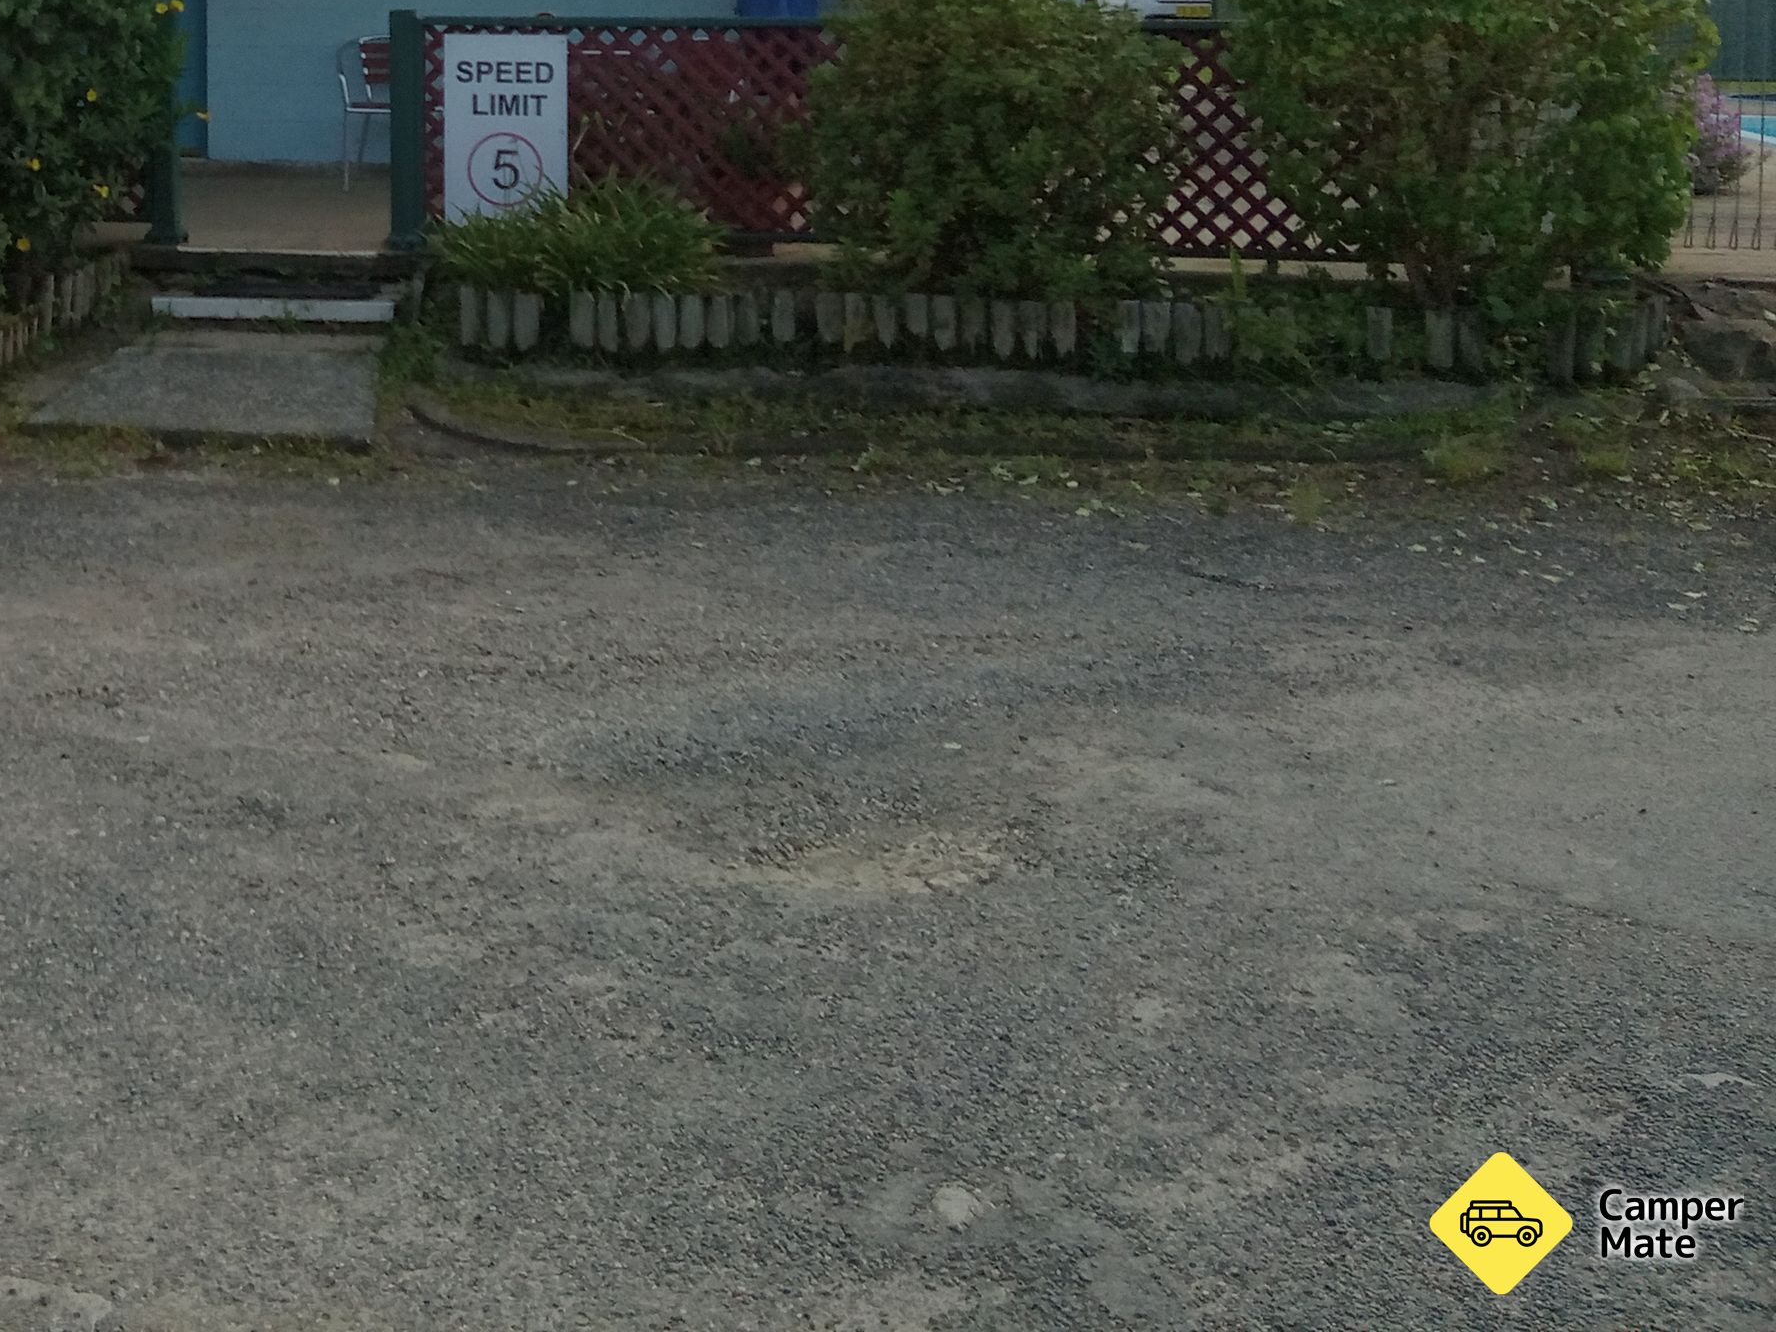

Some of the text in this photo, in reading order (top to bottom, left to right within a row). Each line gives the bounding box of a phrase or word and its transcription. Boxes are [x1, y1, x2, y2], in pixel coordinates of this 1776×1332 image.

[456, 60, 555, 84] SPEED
[472, 93, 548, 117] LIMIT
[492, 149, 520, 190] 5
